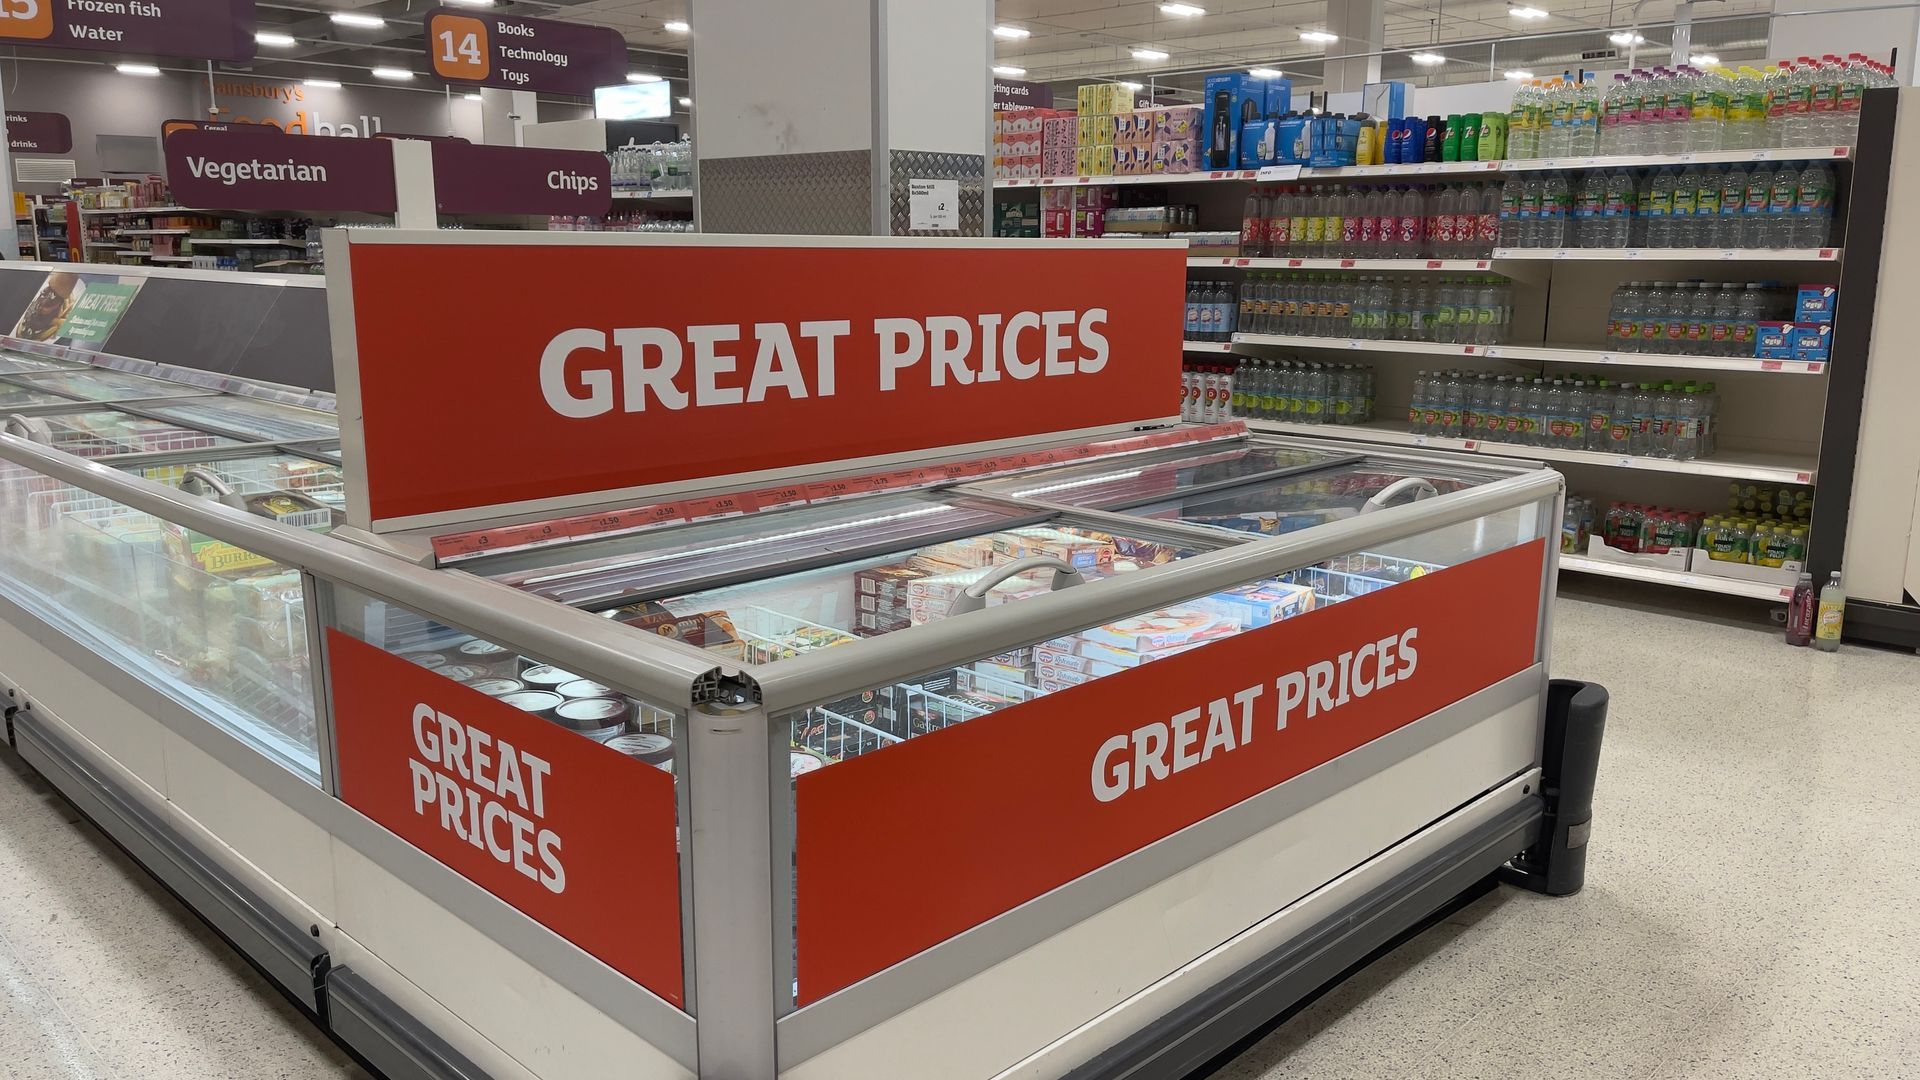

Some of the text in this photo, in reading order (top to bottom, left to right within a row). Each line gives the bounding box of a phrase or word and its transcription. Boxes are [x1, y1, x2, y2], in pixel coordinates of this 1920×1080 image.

[67, 0, 161, 17] Frozen fish
[69, 24, 124, 42] Water
[497, 21, 535, 37] Books
[439, 30, 481, 65] 14
[499, 45, 568, 67] Technology
[500, 68, 530, 85] Toys
[203, 80, 304, 104] ainsbury's
[1011, 86, 1030, 96] cards
[6, 114, 28, 123] rinks
[186, 156, 327, 186] Vegetarian
[547, 170, 598, 195] Chips
[539, 308, 1110, 418] GREAT PRICES
[780, 490, 797, 498] £1.50
[656, 507, 675, 516] £2.50
[716, 500, 733, 508] £1.50
[542, 525, 552, 534] £3
[600, 516, 620, 526] £1.50
[479, 536, 489, 545] £3
[1091, 627, 1418, 803] GREAT PRICES
[412, 703, 551, 819] GREAT
[409, 757, 566, 894] PRICES
